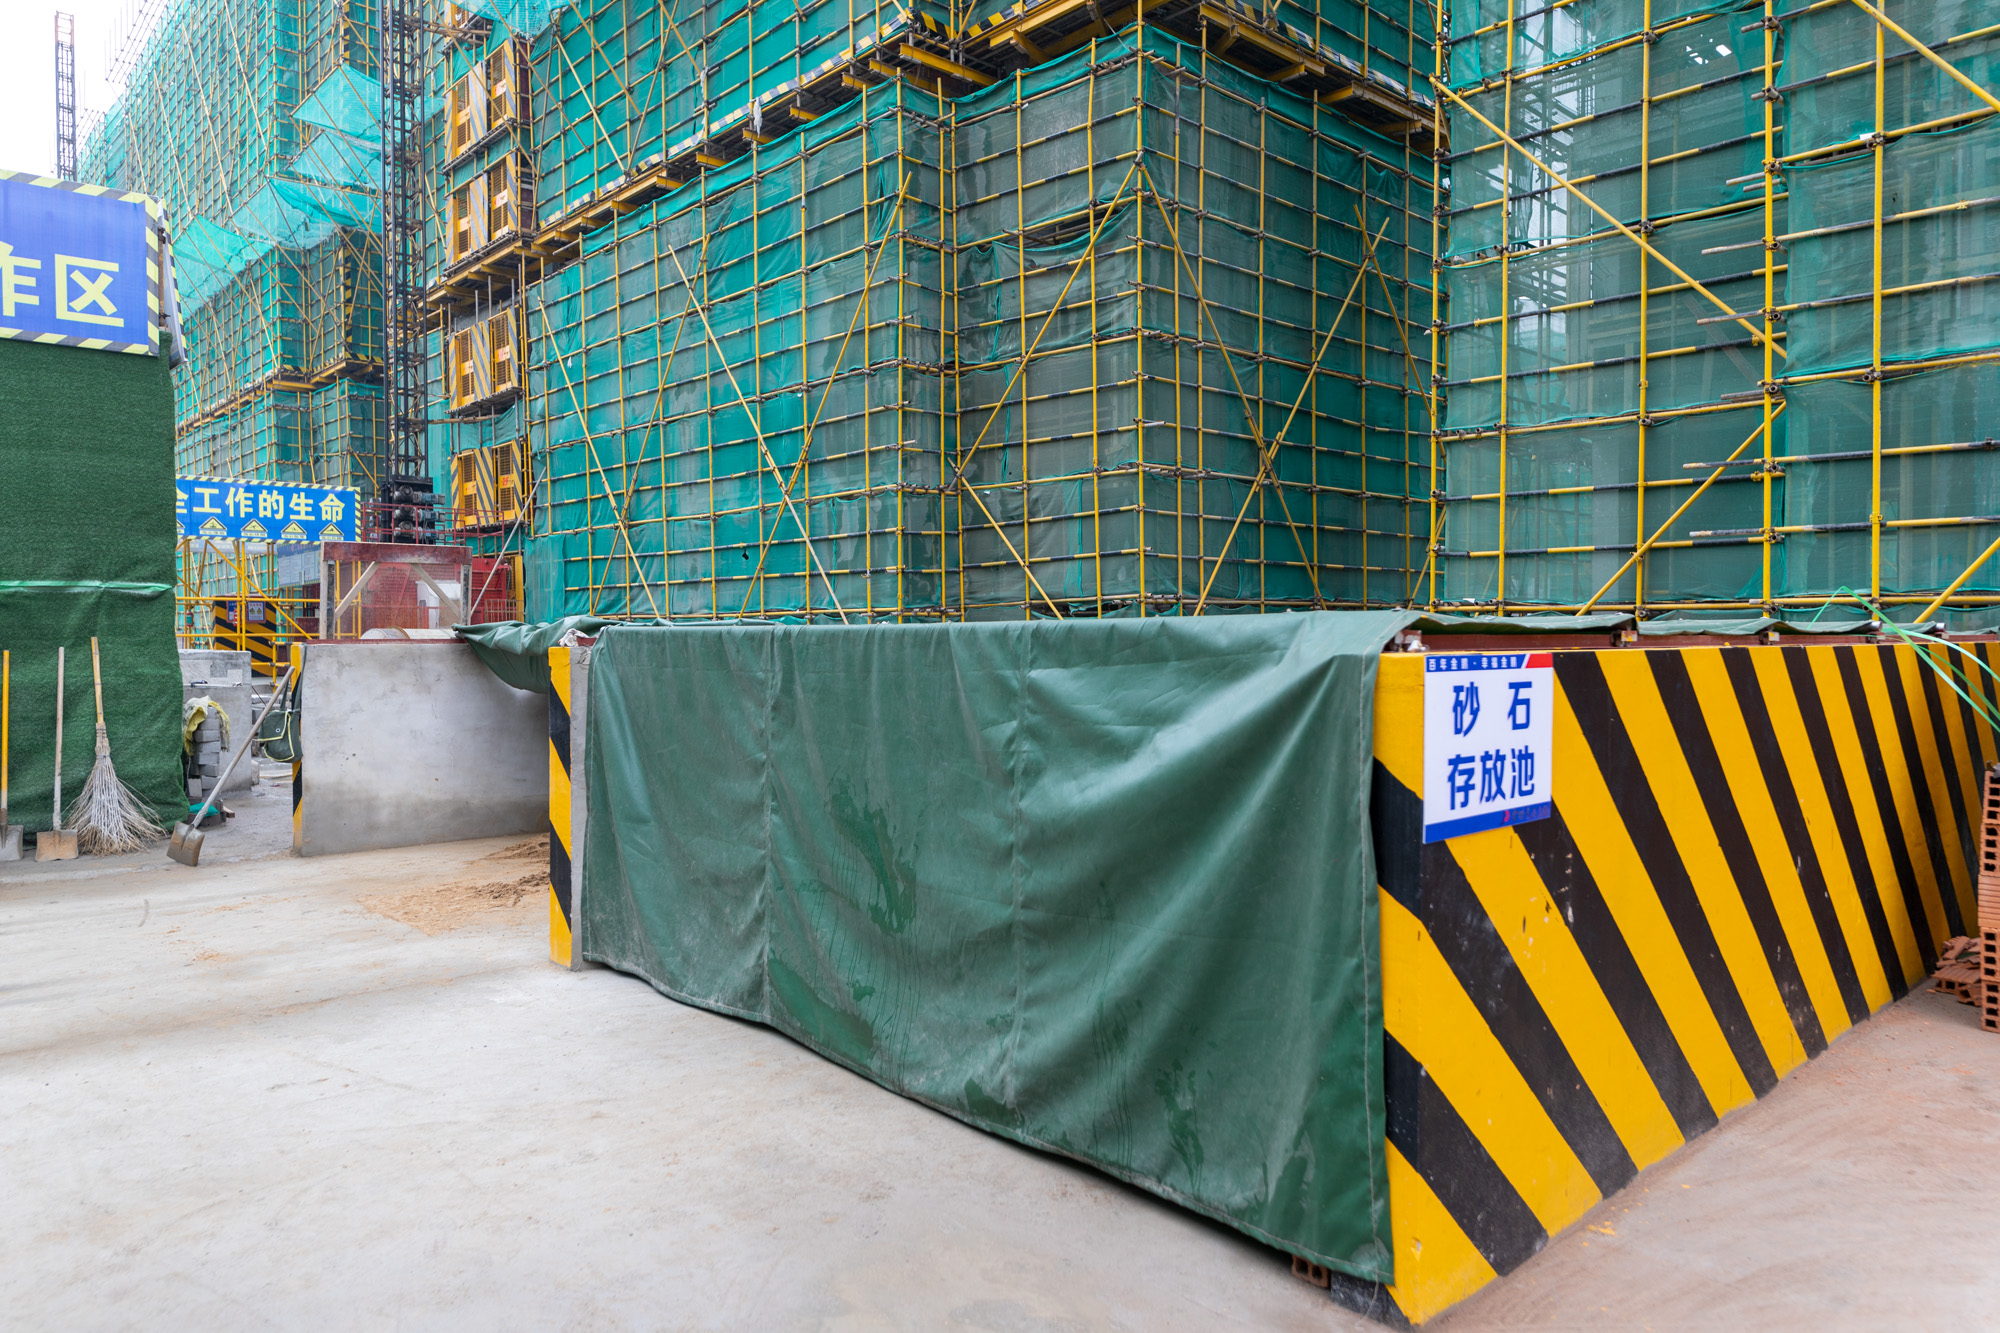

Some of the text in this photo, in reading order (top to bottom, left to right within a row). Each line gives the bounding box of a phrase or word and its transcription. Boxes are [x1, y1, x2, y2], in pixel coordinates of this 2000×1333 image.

[0, 241, 124, 328] 作区
[1453, 681, 1532, 737] 砂石
[1447, 745, 1535, 810] 存放池
